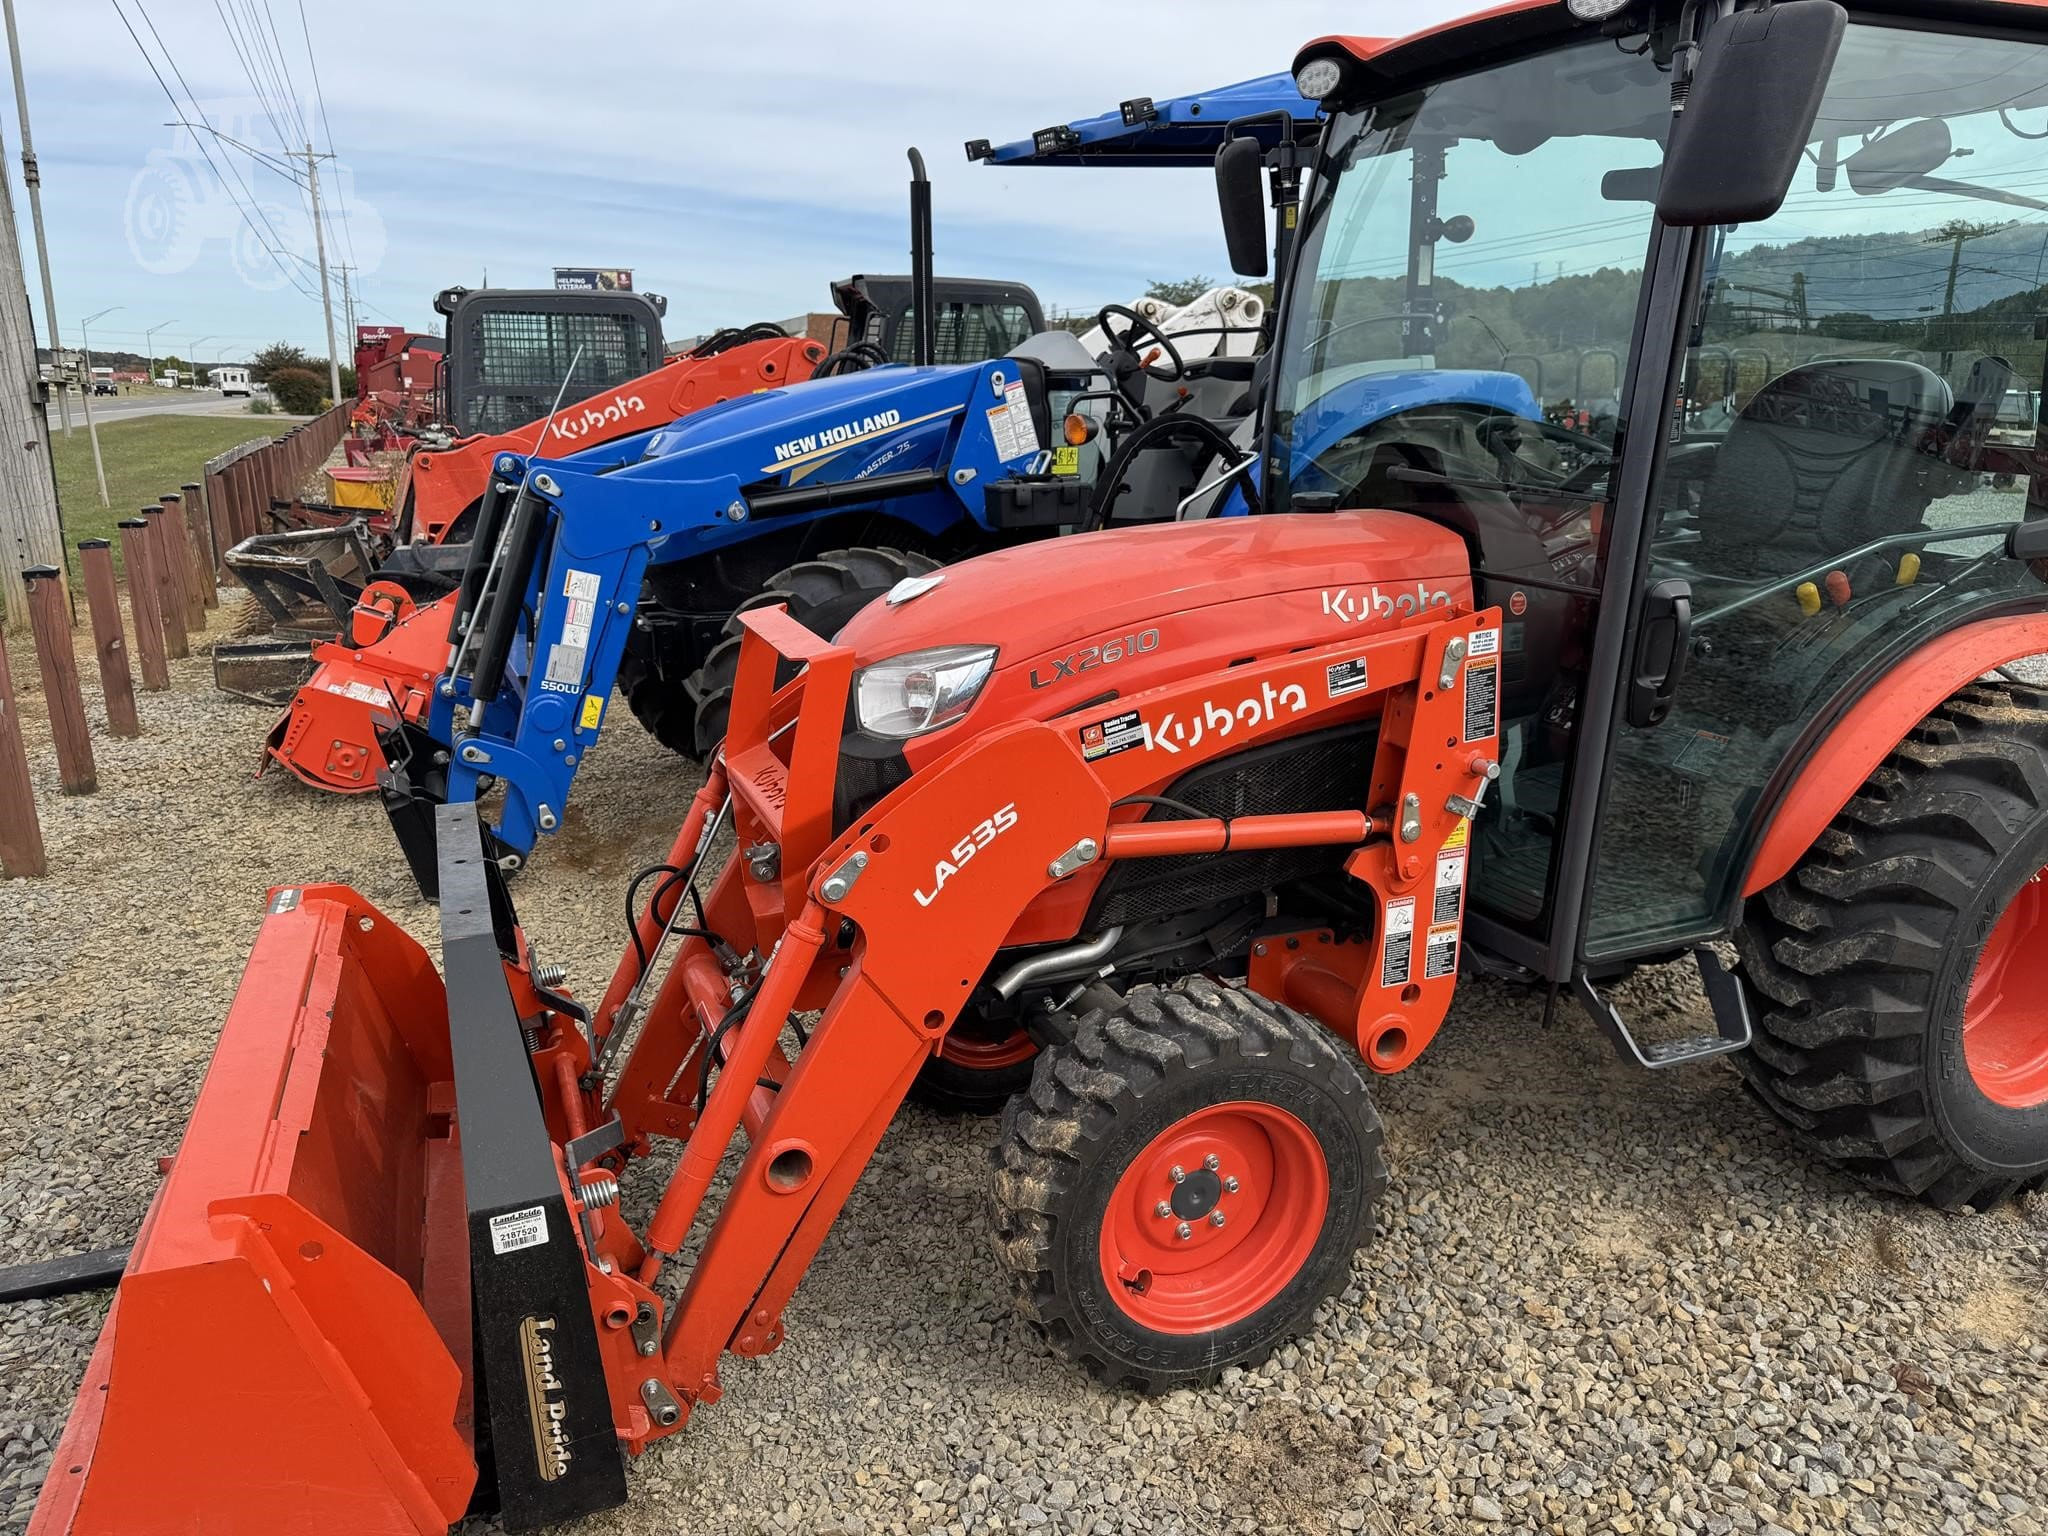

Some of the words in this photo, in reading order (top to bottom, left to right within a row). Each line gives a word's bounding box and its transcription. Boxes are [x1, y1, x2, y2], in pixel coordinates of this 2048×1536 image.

[551, 396, 645, 440] Kubota
[774, 434, 817, 461] NEW
[818, 409, 900, 447] HOLLAND
[854, 450, 894, 480] MASTER
[1321, 583, 1452, 622] Kubota
[1475, 632, 1492, 640] NOTICE
[1029, 629, 1160, 690] LX2610
[1472, 658, 1496, 668] WARNING
[540, 681, 580, 694] 550LU
[1141, 681, 1307, 754] Kubota
[913, 802, 1018, 907] LA535
[494, 1214, 516, 1224] Land
[518, 1208, 543, 1219] Pride
[499, 1226, 539, 1242] 2187520
[529, 1317, 562, 1393] Land
[538, 1400, 573, 1479] Pride
